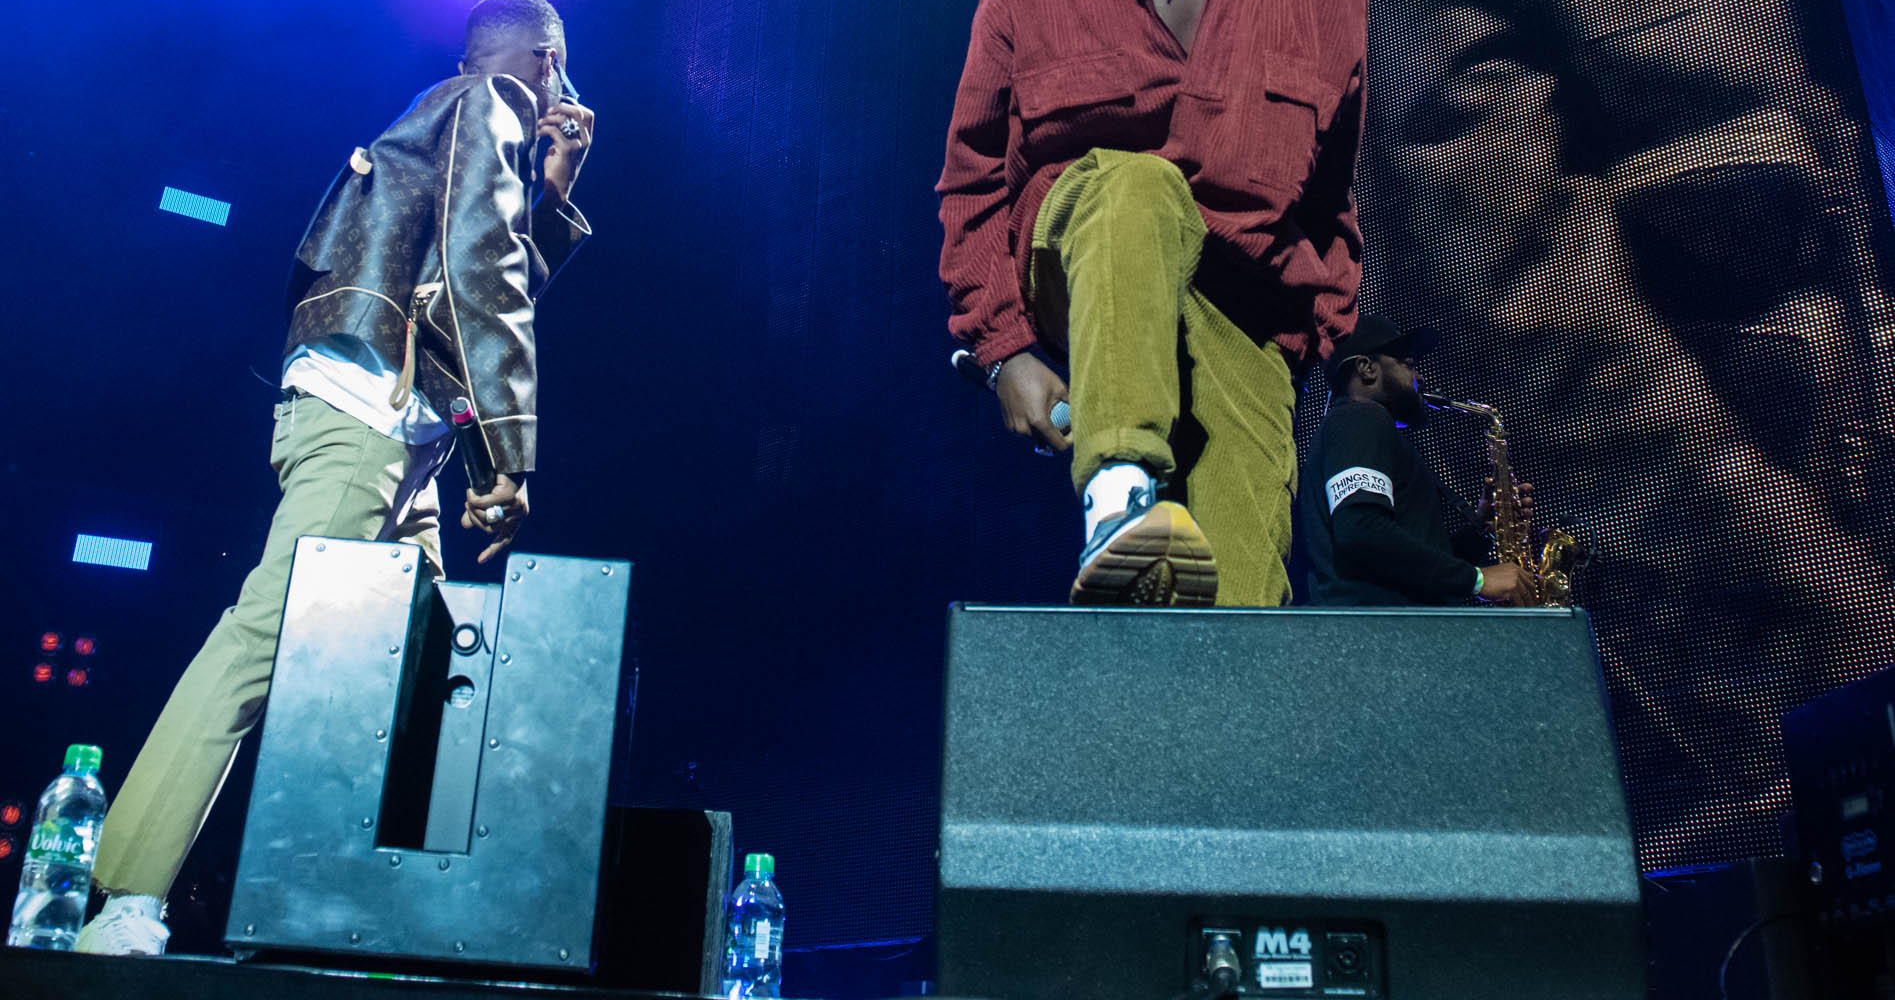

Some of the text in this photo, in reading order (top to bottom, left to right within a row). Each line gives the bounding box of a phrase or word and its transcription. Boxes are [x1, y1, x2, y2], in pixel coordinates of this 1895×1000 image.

[1330, 473, 1386, 493] THINGS TO
[31, 833, 81, 854] Volvic
[1255, 928, 1312, 954] M4
